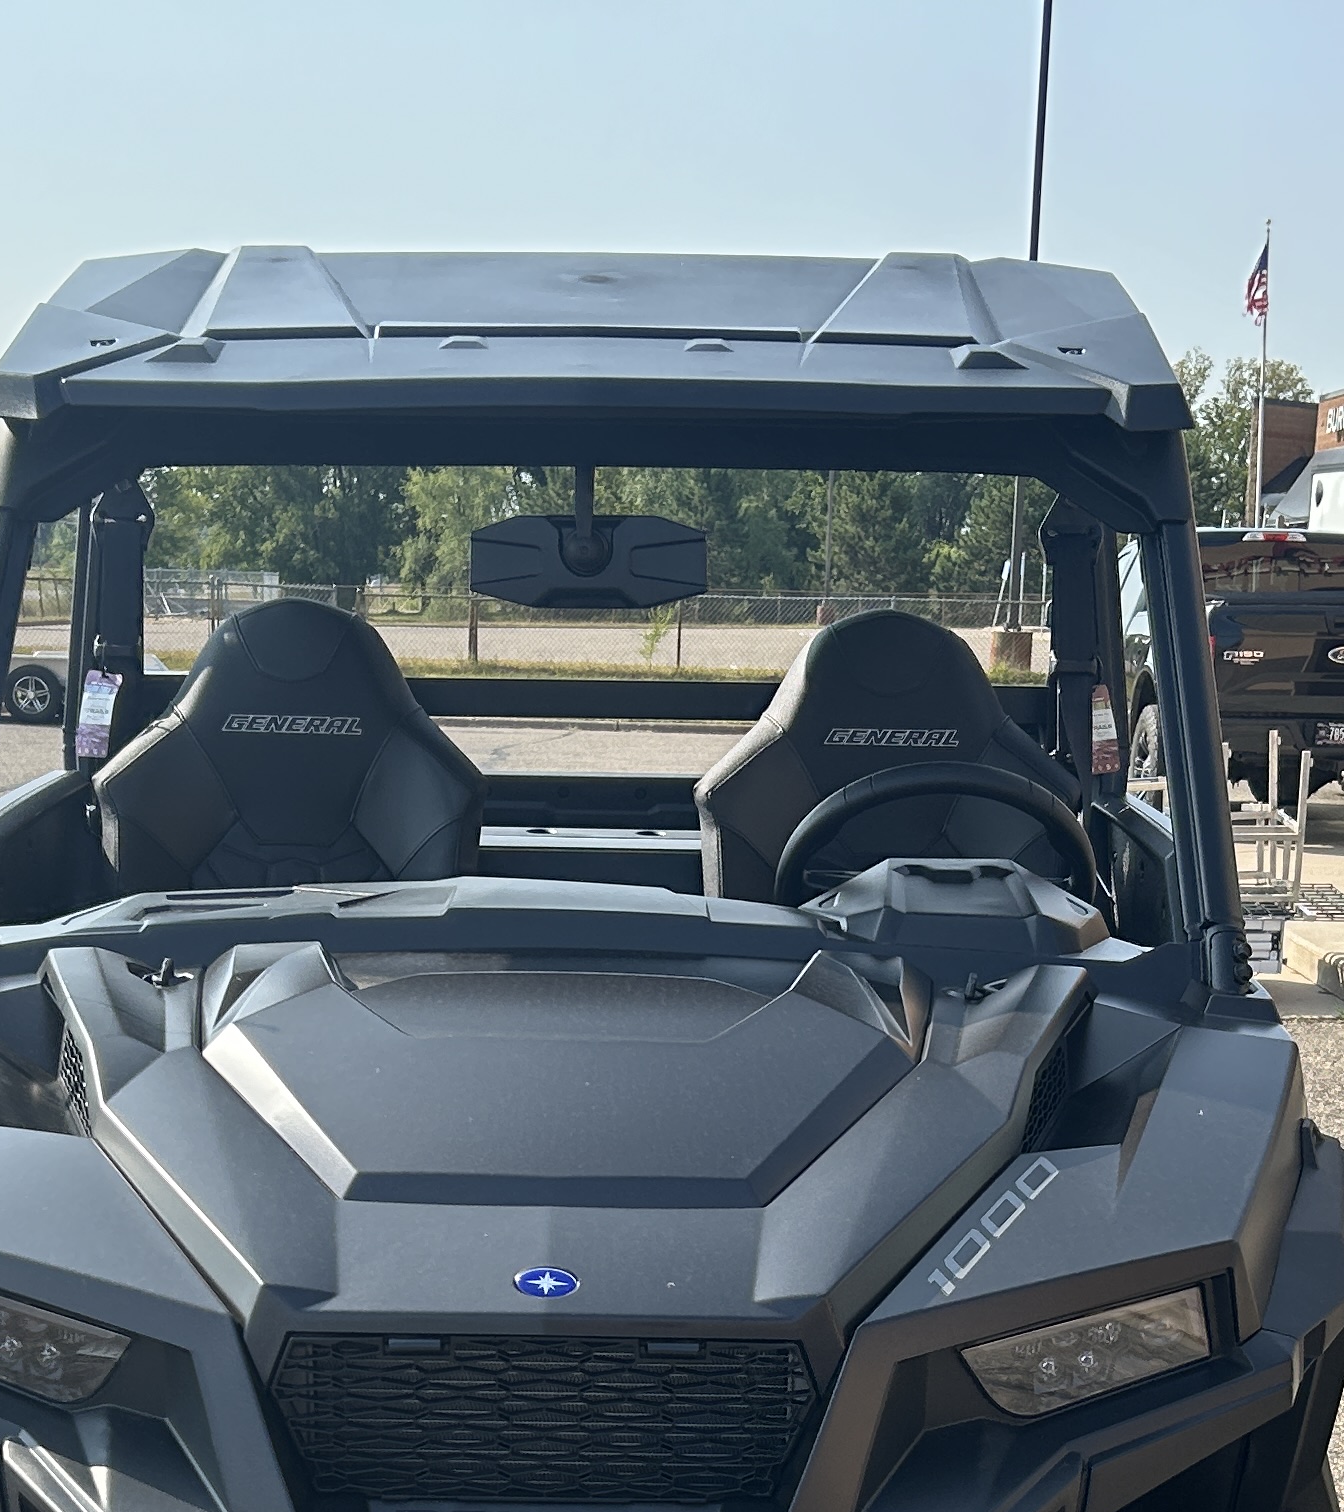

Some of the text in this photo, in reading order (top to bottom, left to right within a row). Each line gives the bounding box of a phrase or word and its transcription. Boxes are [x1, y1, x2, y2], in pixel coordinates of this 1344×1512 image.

[221, 714, 363, 735] GENERAL
[823, 728, 960, 748] GENERAL
[927, 1156, 1060, 1296] 1000
